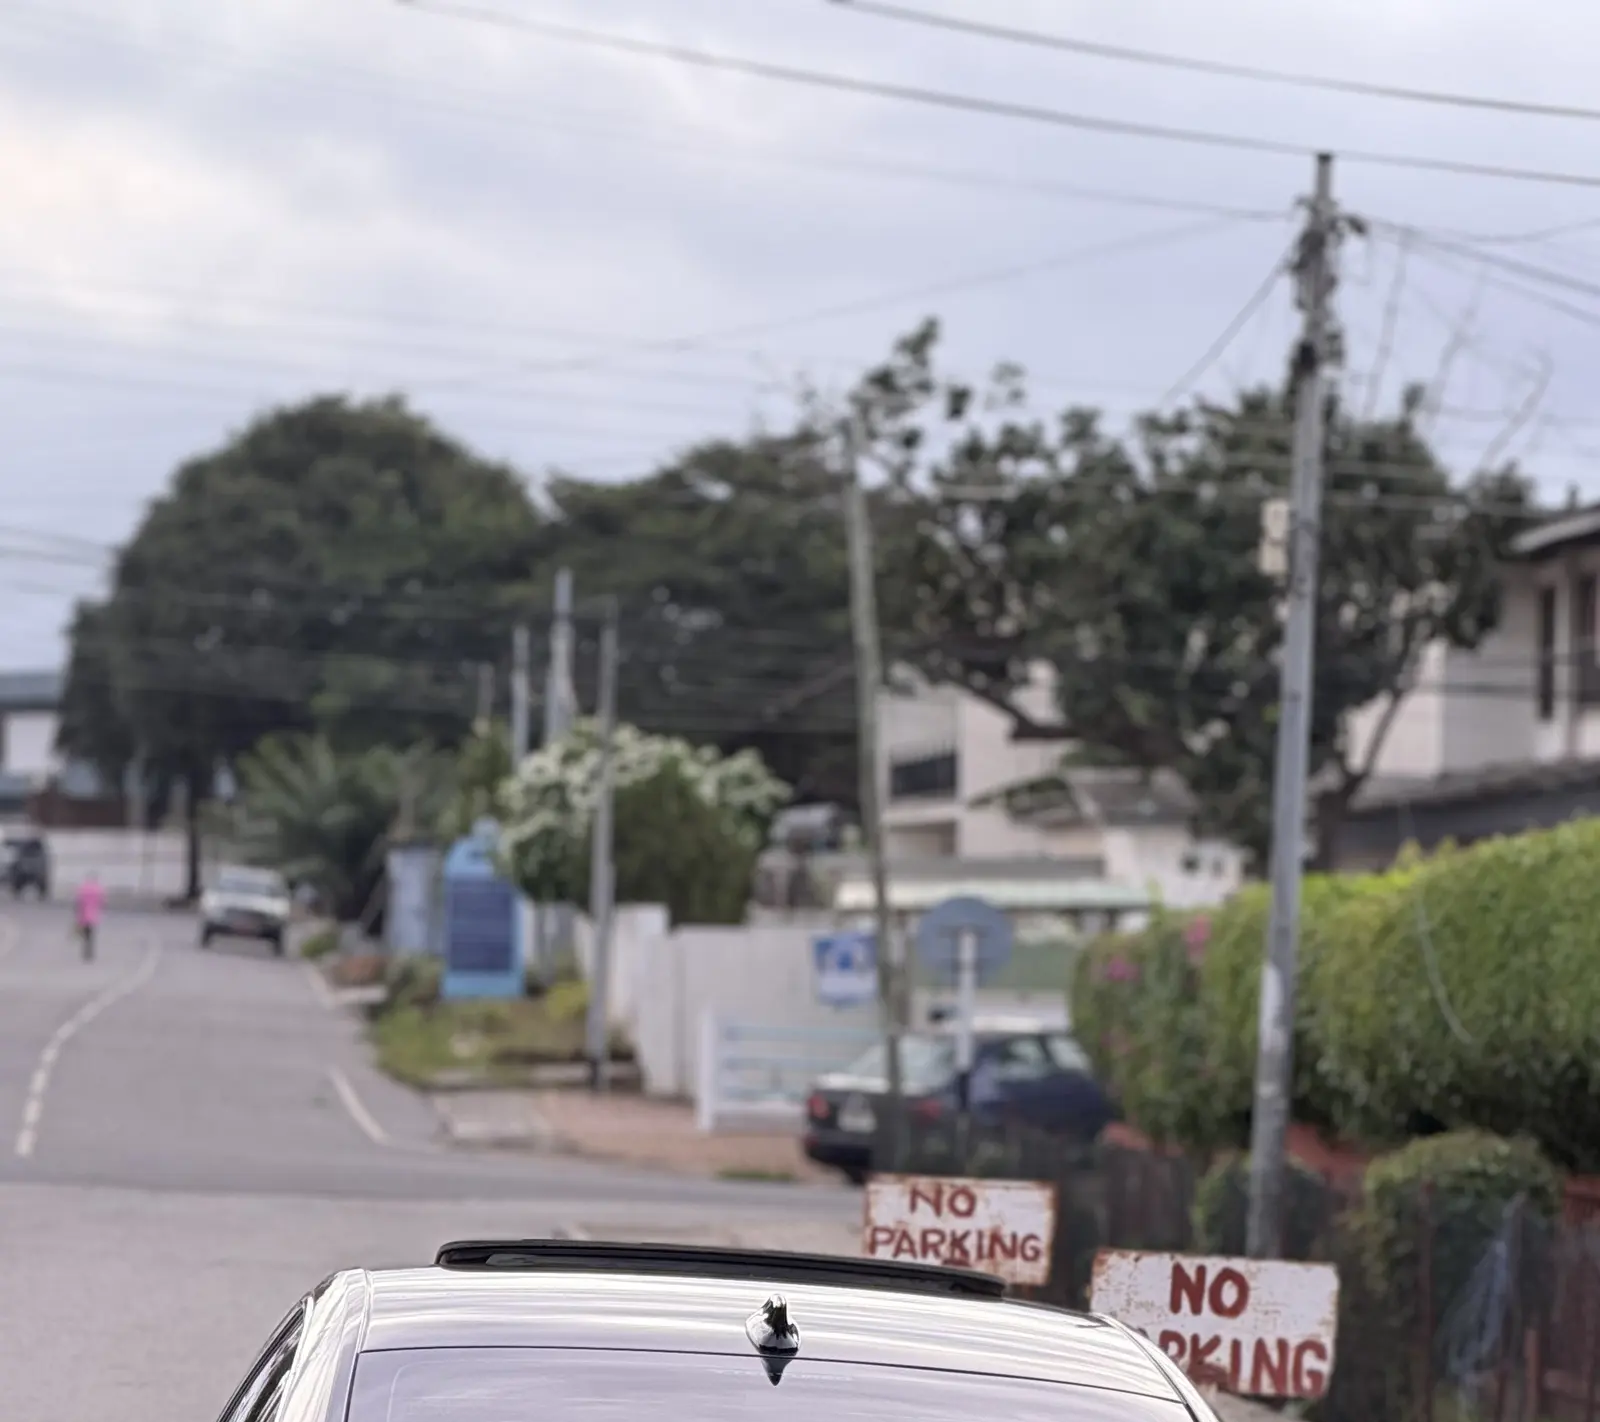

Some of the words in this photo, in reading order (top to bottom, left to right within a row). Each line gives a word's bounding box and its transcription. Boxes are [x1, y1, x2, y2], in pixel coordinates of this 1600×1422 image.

[909, 1183, 978, 1218] NO
[868, 1226, 1042, 1264] PARKING
[1169, 1262, 1250, 1318] NO
[1137, 1328, 1328, 1397] RKING
